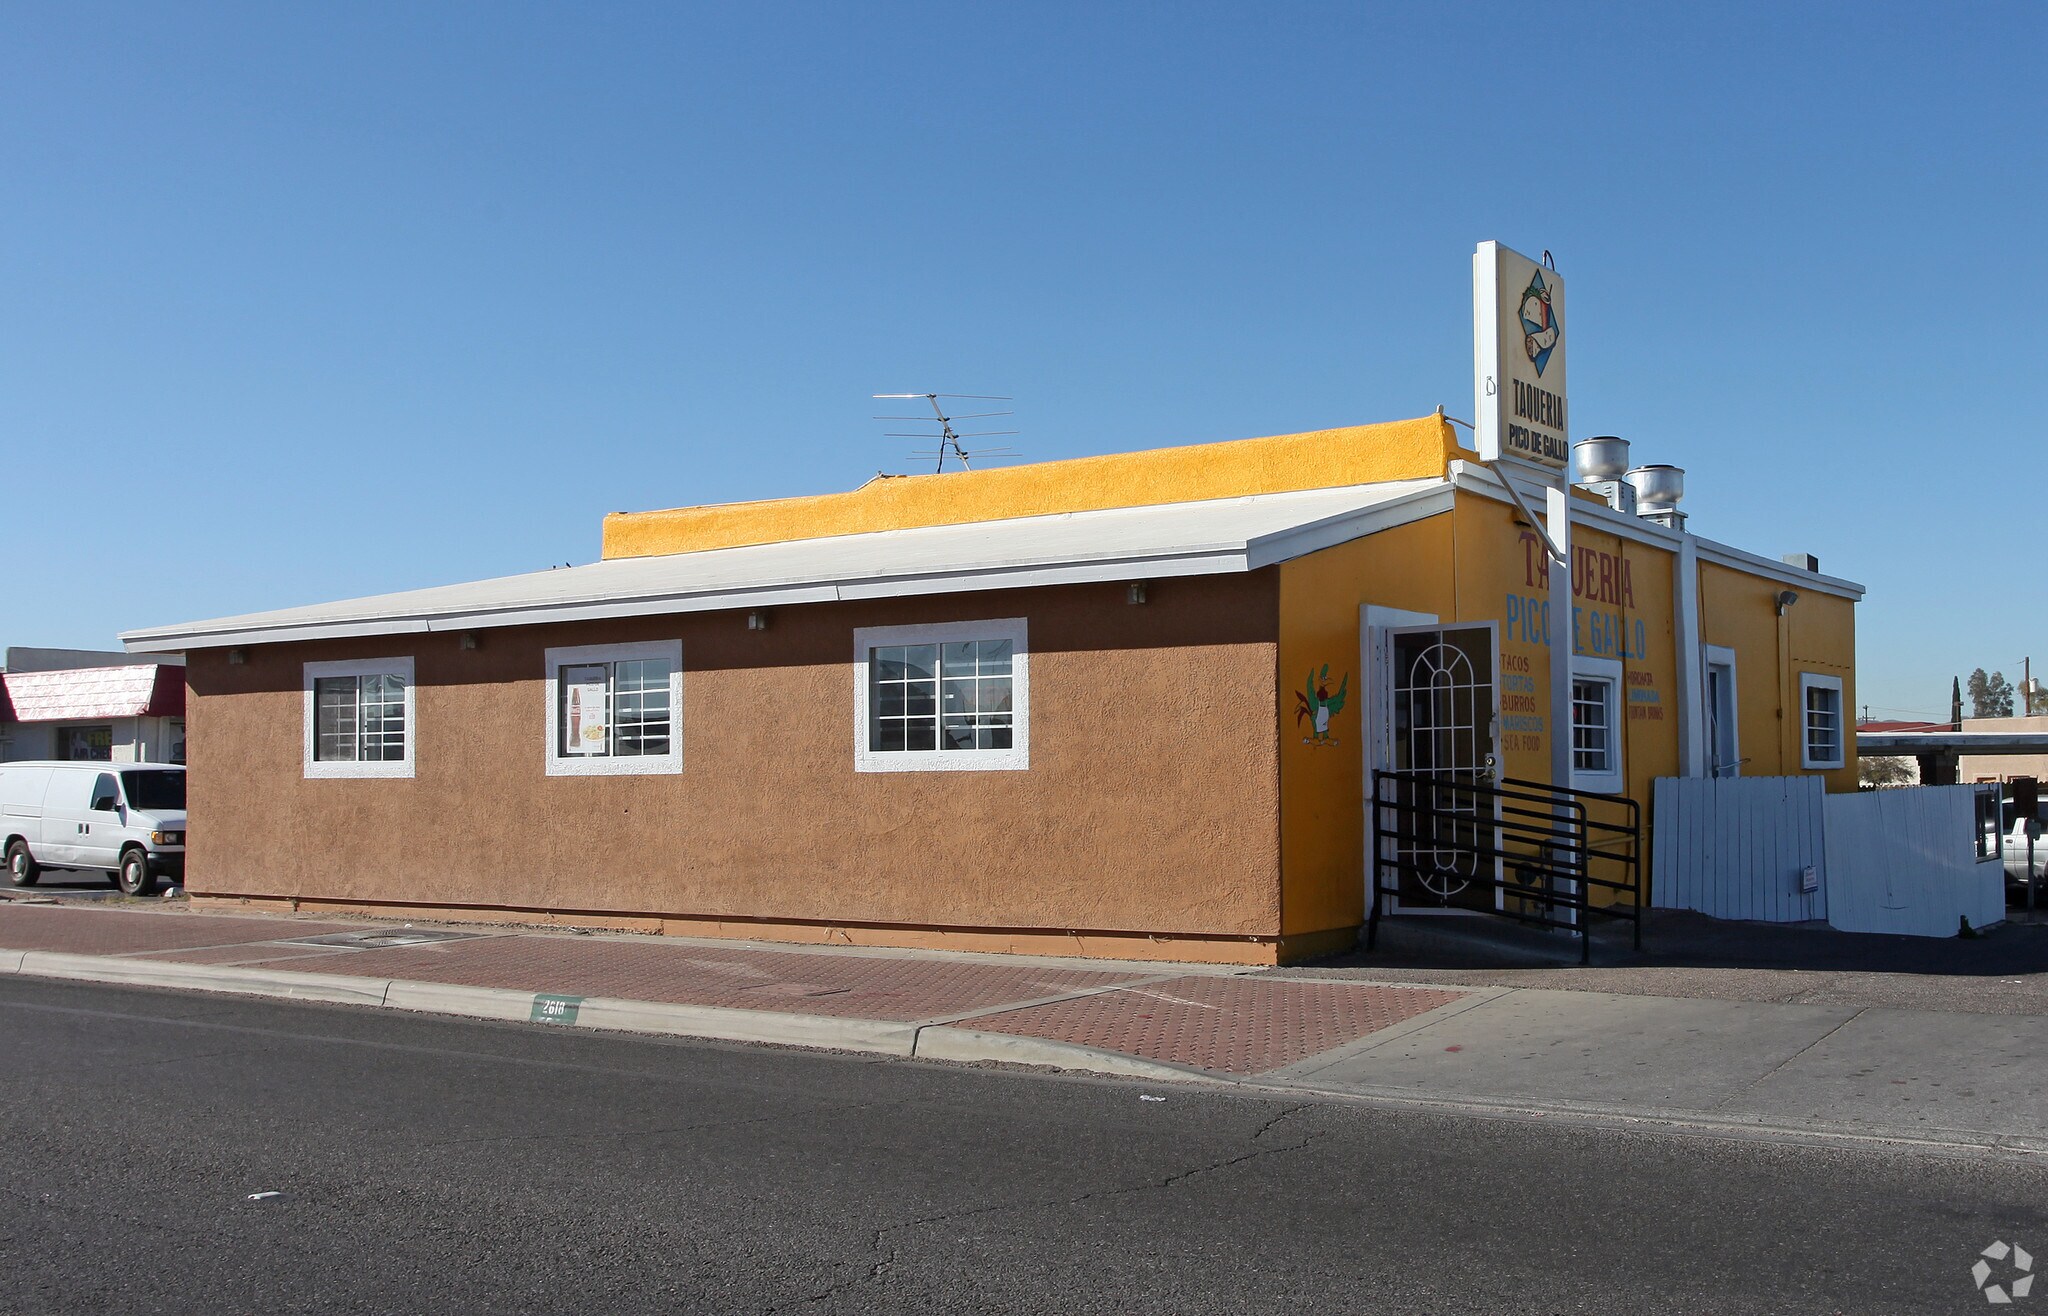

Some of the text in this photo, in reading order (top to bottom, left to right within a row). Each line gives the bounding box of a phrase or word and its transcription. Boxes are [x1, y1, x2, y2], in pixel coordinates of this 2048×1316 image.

[1512, 378, 1564, 431] TAQUERIA
[1509, 423, 1569, 462] PICO DE GALLO
[1518, 530, 1635, 609] TAUERIA
[1506, 593, 1647, 660] PICO E GALLO
[1500, 653, 1530, 673] TACOS
[1501, 673, 1536, 694] TORTAS
[1501, 694, 1536, 713] BURROS
[1504, 734, 1541, 752] SEA FOOD
